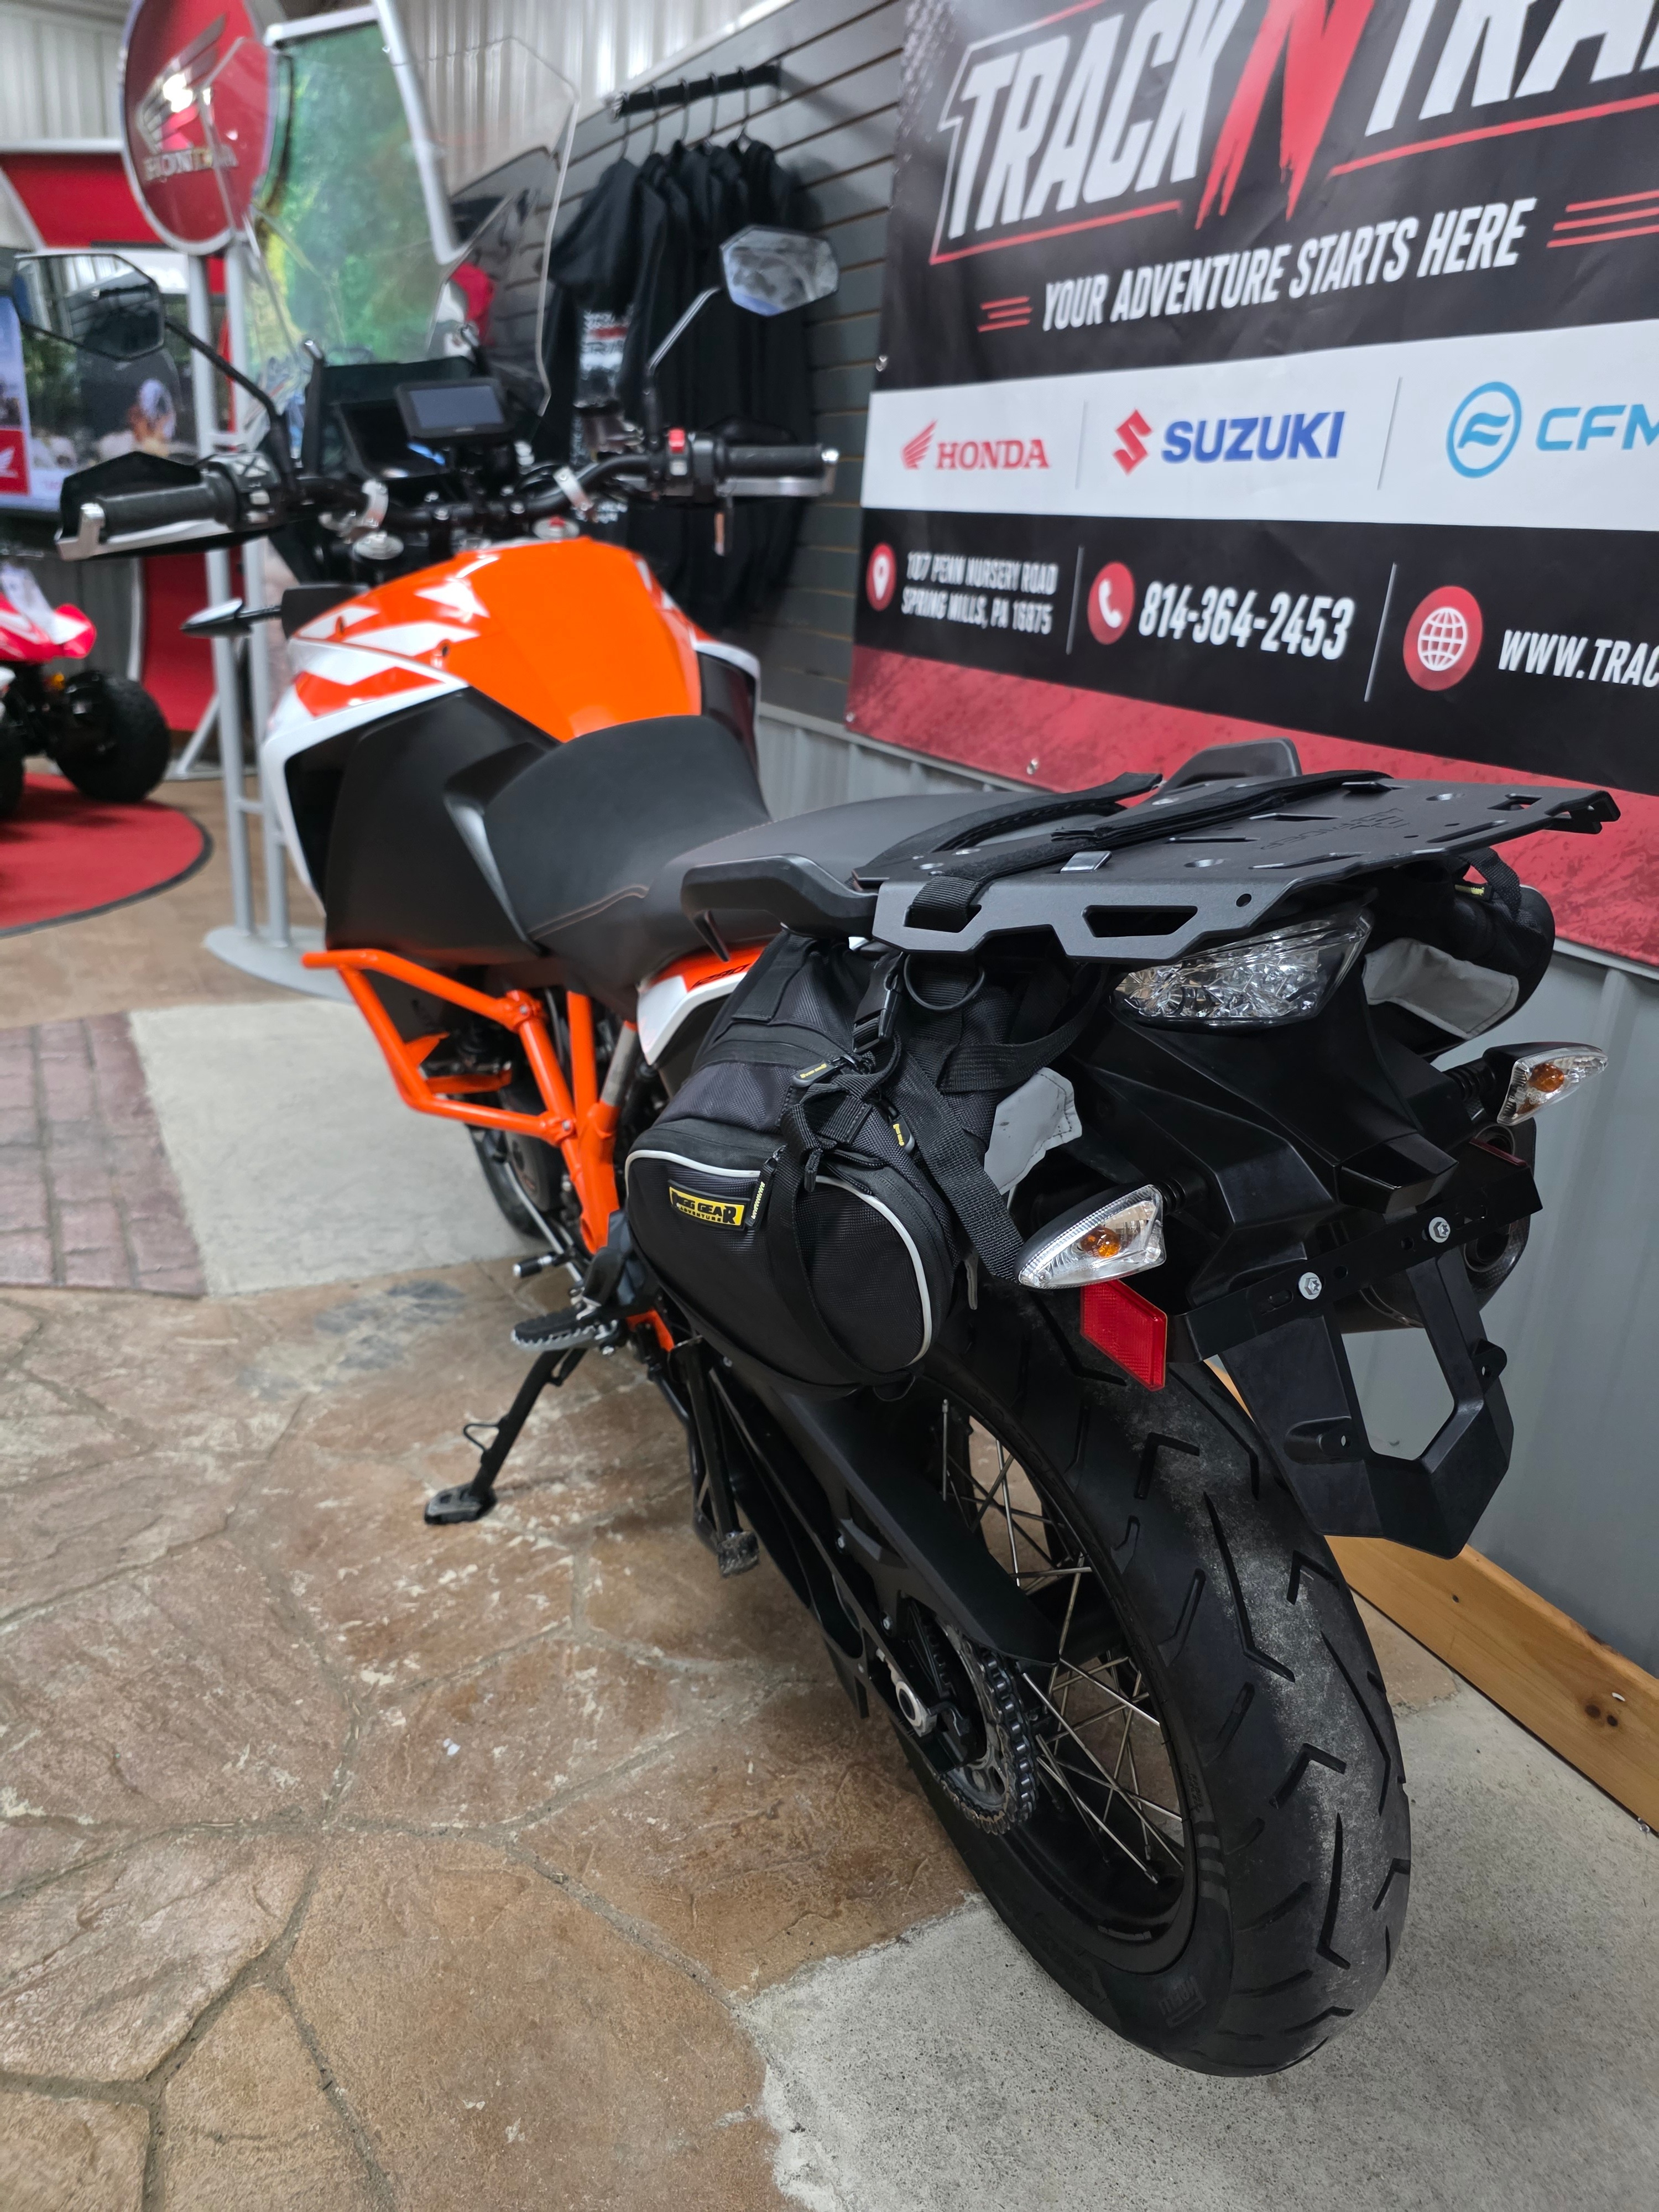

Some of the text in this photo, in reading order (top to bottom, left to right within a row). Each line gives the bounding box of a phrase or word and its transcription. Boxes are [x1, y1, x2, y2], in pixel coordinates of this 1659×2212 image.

[948, 0, 1245, 240] TRACK
[1043, 197, 1537, 331] YOUR ADVENTURE STARTS HERE
[935, 439, 1050, 470] HONDA
[1161, 411, 1346, 464] SUZUKI
[931, 554, 967, 585] PENN
[965, 556, 1022, 591] NURSERY
[1021, 561, 1058, 595] ROAD
[901, 586, 949, 619] SPRING
[990, 596, 1010, 628] PA
[1138, 581, 1355, 660] 814-364-2453
[697, 1202, 737, 1224] GEAR
